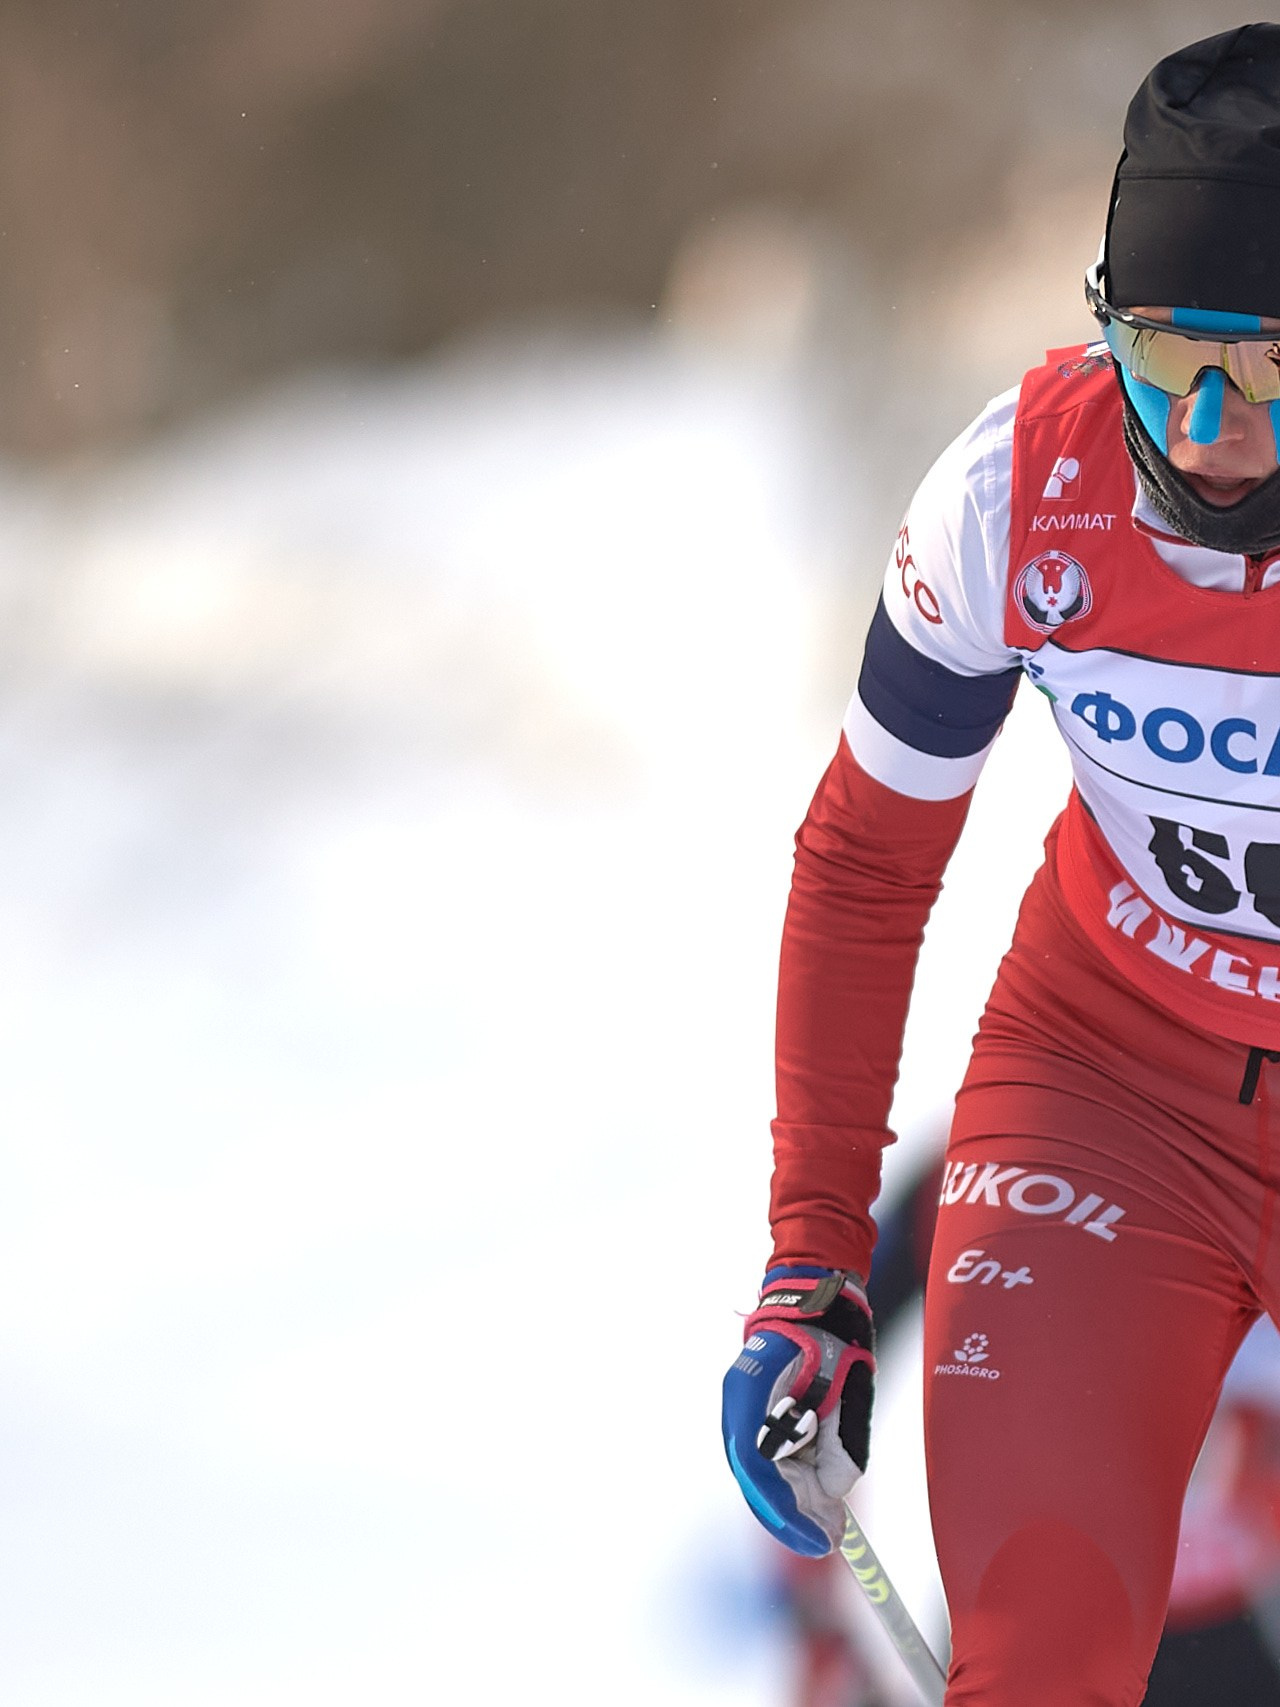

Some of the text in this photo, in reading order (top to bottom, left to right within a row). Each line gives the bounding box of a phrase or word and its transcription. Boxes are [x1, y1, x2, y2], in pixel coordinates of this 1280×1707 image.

[1028, 513, 1117, 532] КЛИМАТ
[896, 523, 944, 625] SCO
[934, 1364, 1001, 1380] PHOSAGRO
